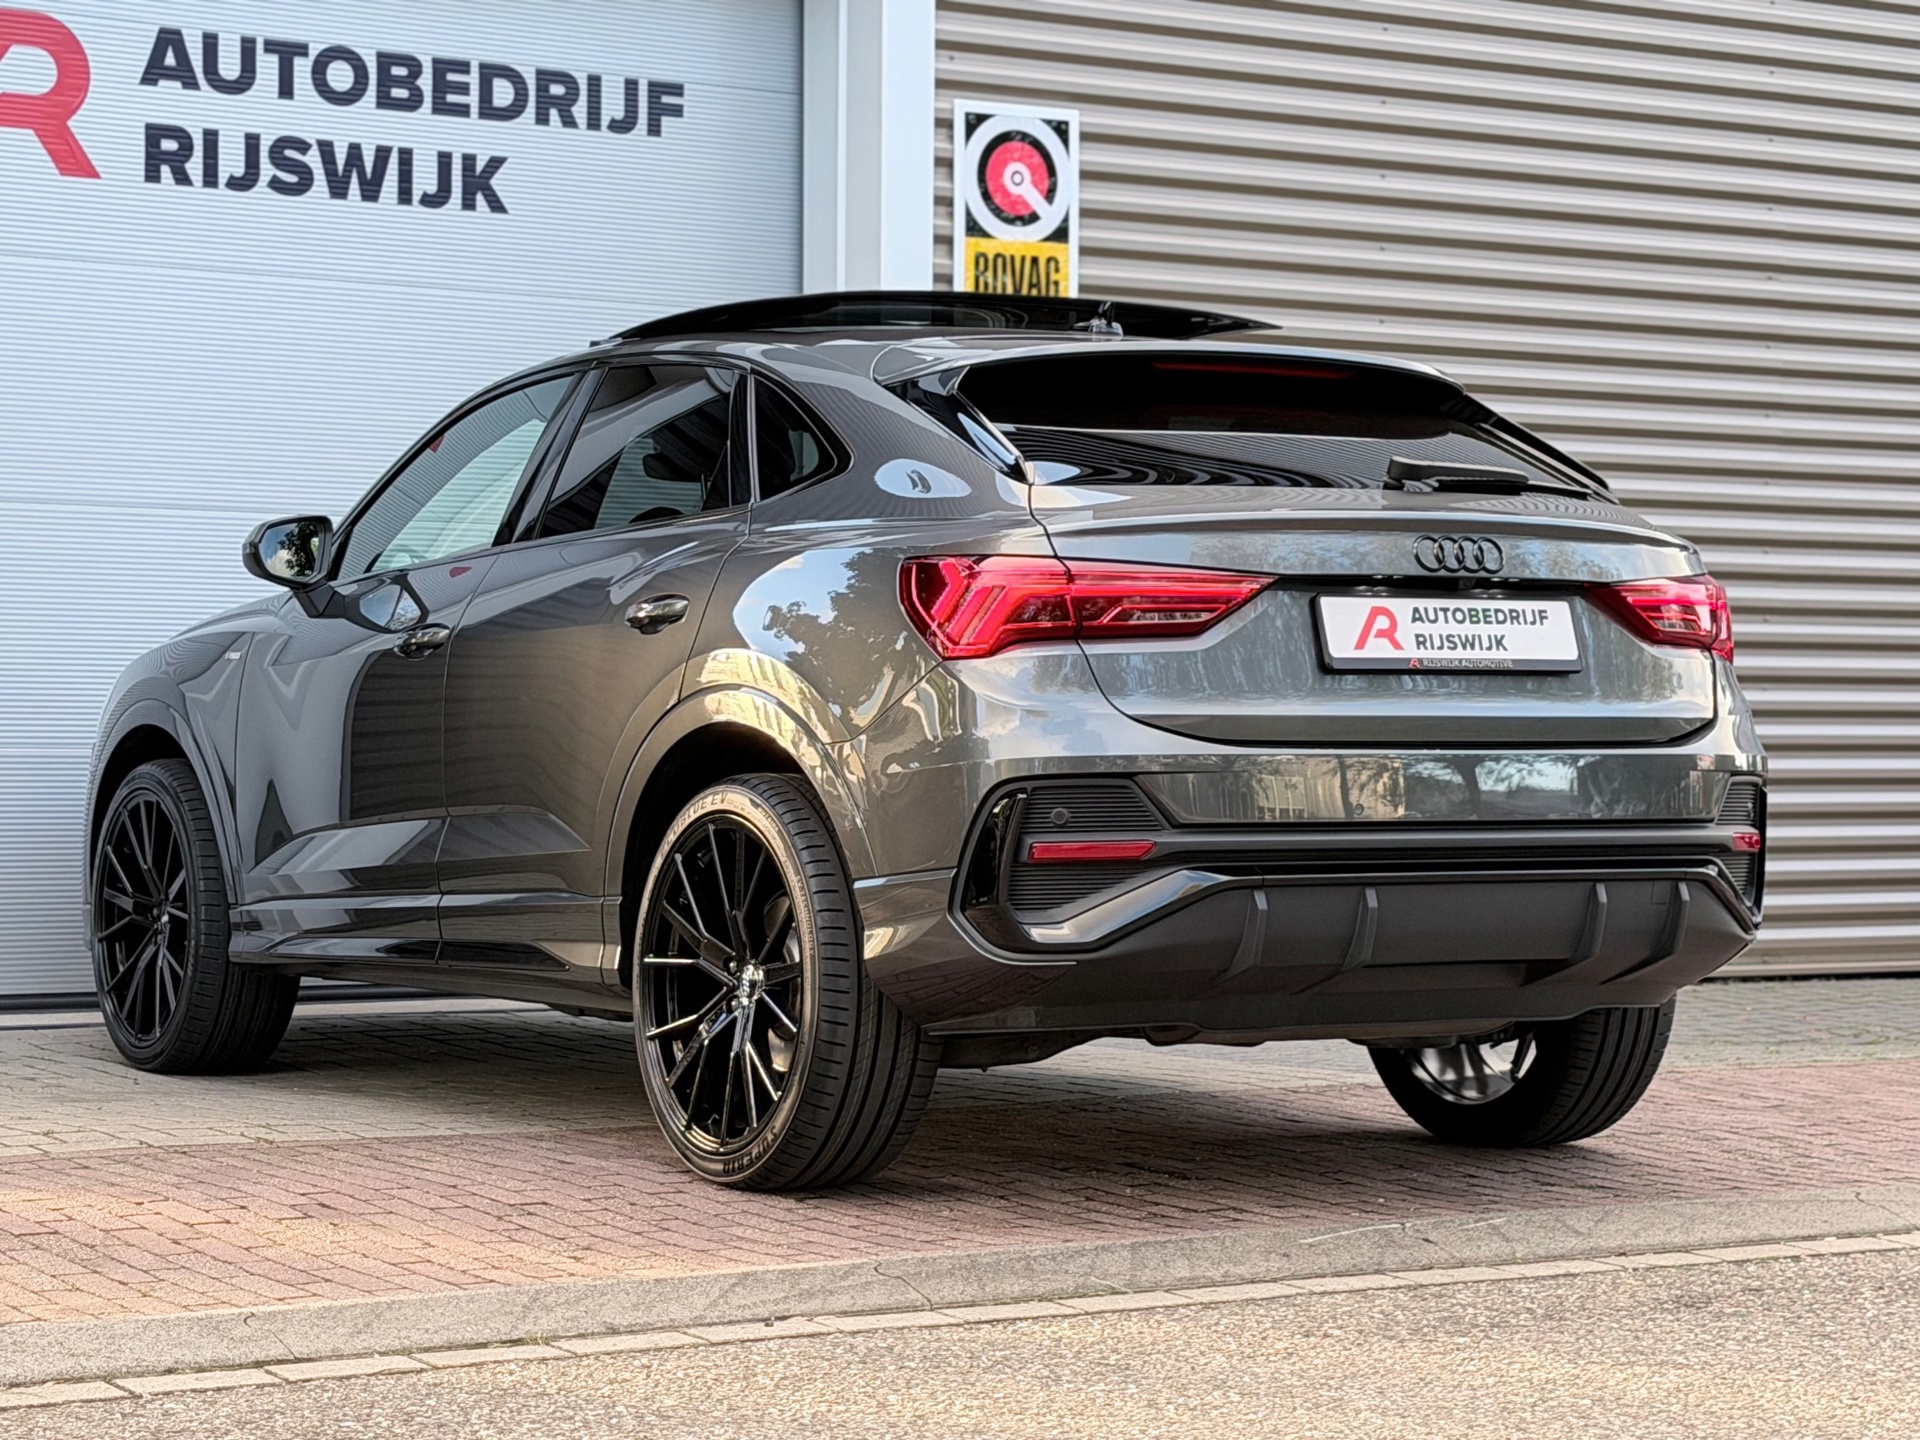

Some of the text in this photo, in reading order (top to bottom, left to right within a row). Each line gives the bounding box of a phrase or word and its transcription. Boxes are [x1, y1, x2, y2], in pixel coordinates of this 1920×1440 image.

[139, 27, 685, 138] AUTOBEDRIJF
[143, 122, 510, 215] RIJSWIJK
[974, 251, 1061, 297] BOVAG
[1410, 606, 1549, 627] AUTOBEDRIJF
[1414, 632, 1509, 652] RIJSWIJK
[1422, 658, 1460, 668] RIJSWIJK
[1461, 658, 1514, 668] AUTOMOTIVE
[710, 791, 729, 806] EV
[800, 890, 815, 955] TECHNOLOGY
[722, 1124, 779, 1174] SUPERIA
